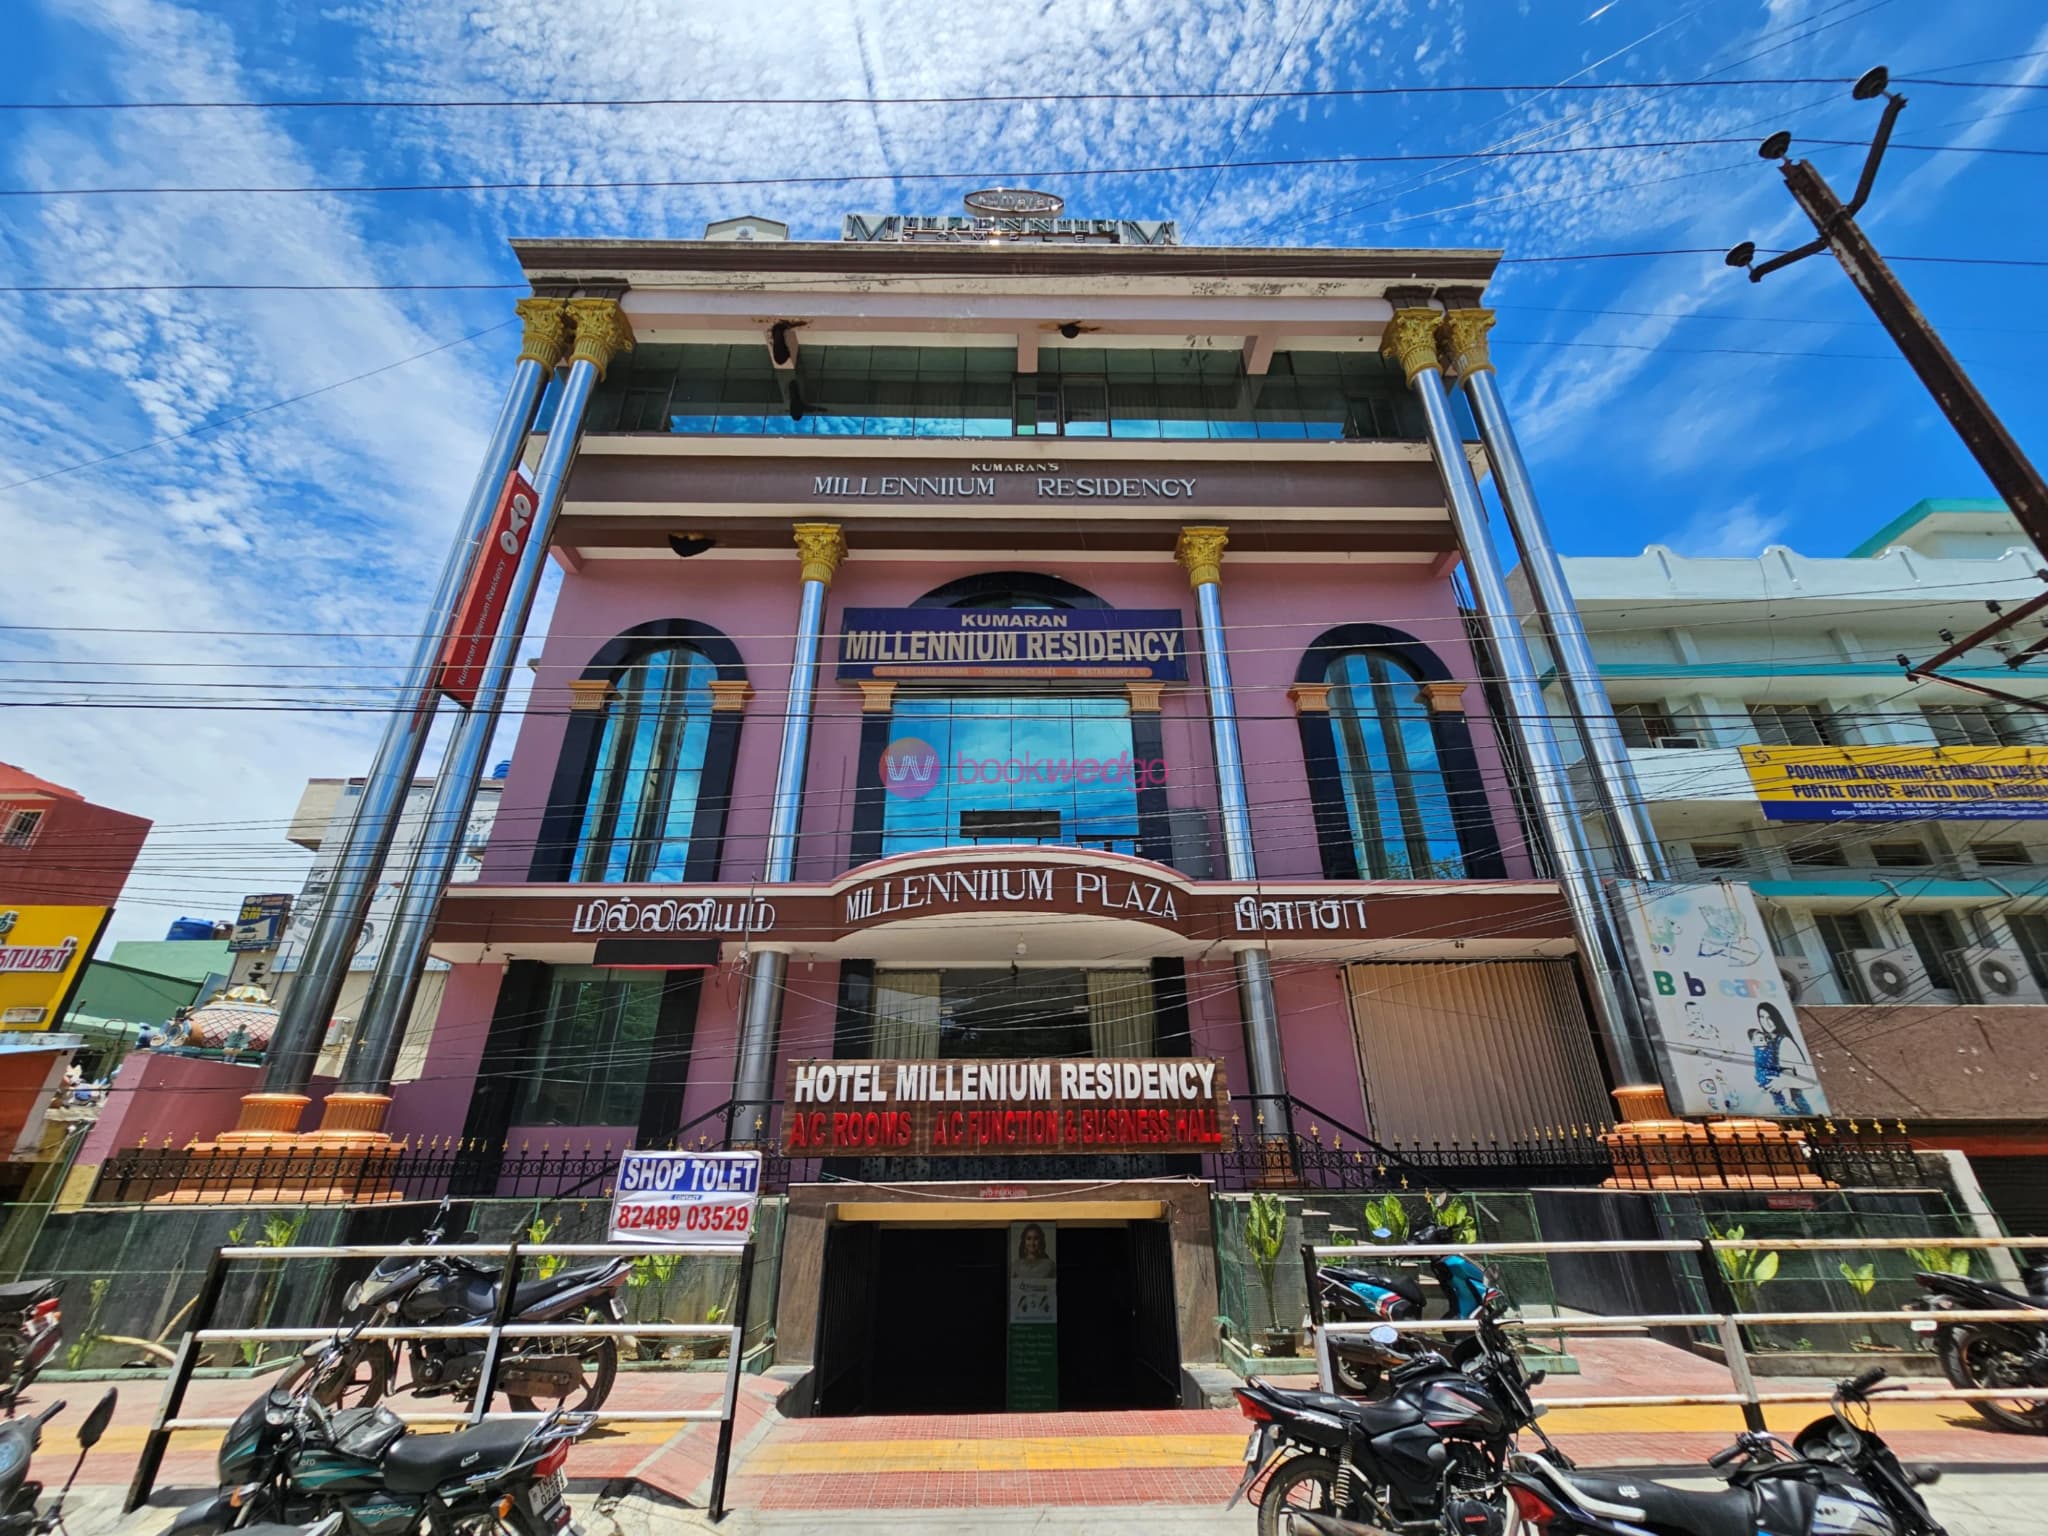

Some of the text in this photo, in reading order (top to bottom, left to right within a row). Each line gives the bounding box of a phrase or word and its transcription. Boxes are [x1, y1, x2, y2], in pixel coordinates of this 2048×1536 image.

[971, 463, 1059, 472] KUMARAN'S
[813, 477, 1196, 497] MILLENNIIUM RESIDENCY
[500, 493, 532, 556] OYO
[961, 614, 1067, 628] KUMARAN
[845, 630, 1178, 662] MILLENNIUM RESIDENCY
[846, 869, 1178, 924] MILLENNIIUM PLAZA
[795, 1063, 1215, 1102] HOTEL MILLENIUM RESIDENCY
[832, 1112, 912, 1147] ROOMS
[968, 1109, 1059, 1144] FUNCTION
[1065, 1110, 1077, 1144] &
[1082, 1109, 1170, 1144] BUSINESS
[1175, 1109, 1223, 1144] HALL
[624, 1158, 756, 1191] SHOP TOLET
[618, 1205, 748, 1231] 82489 03529
